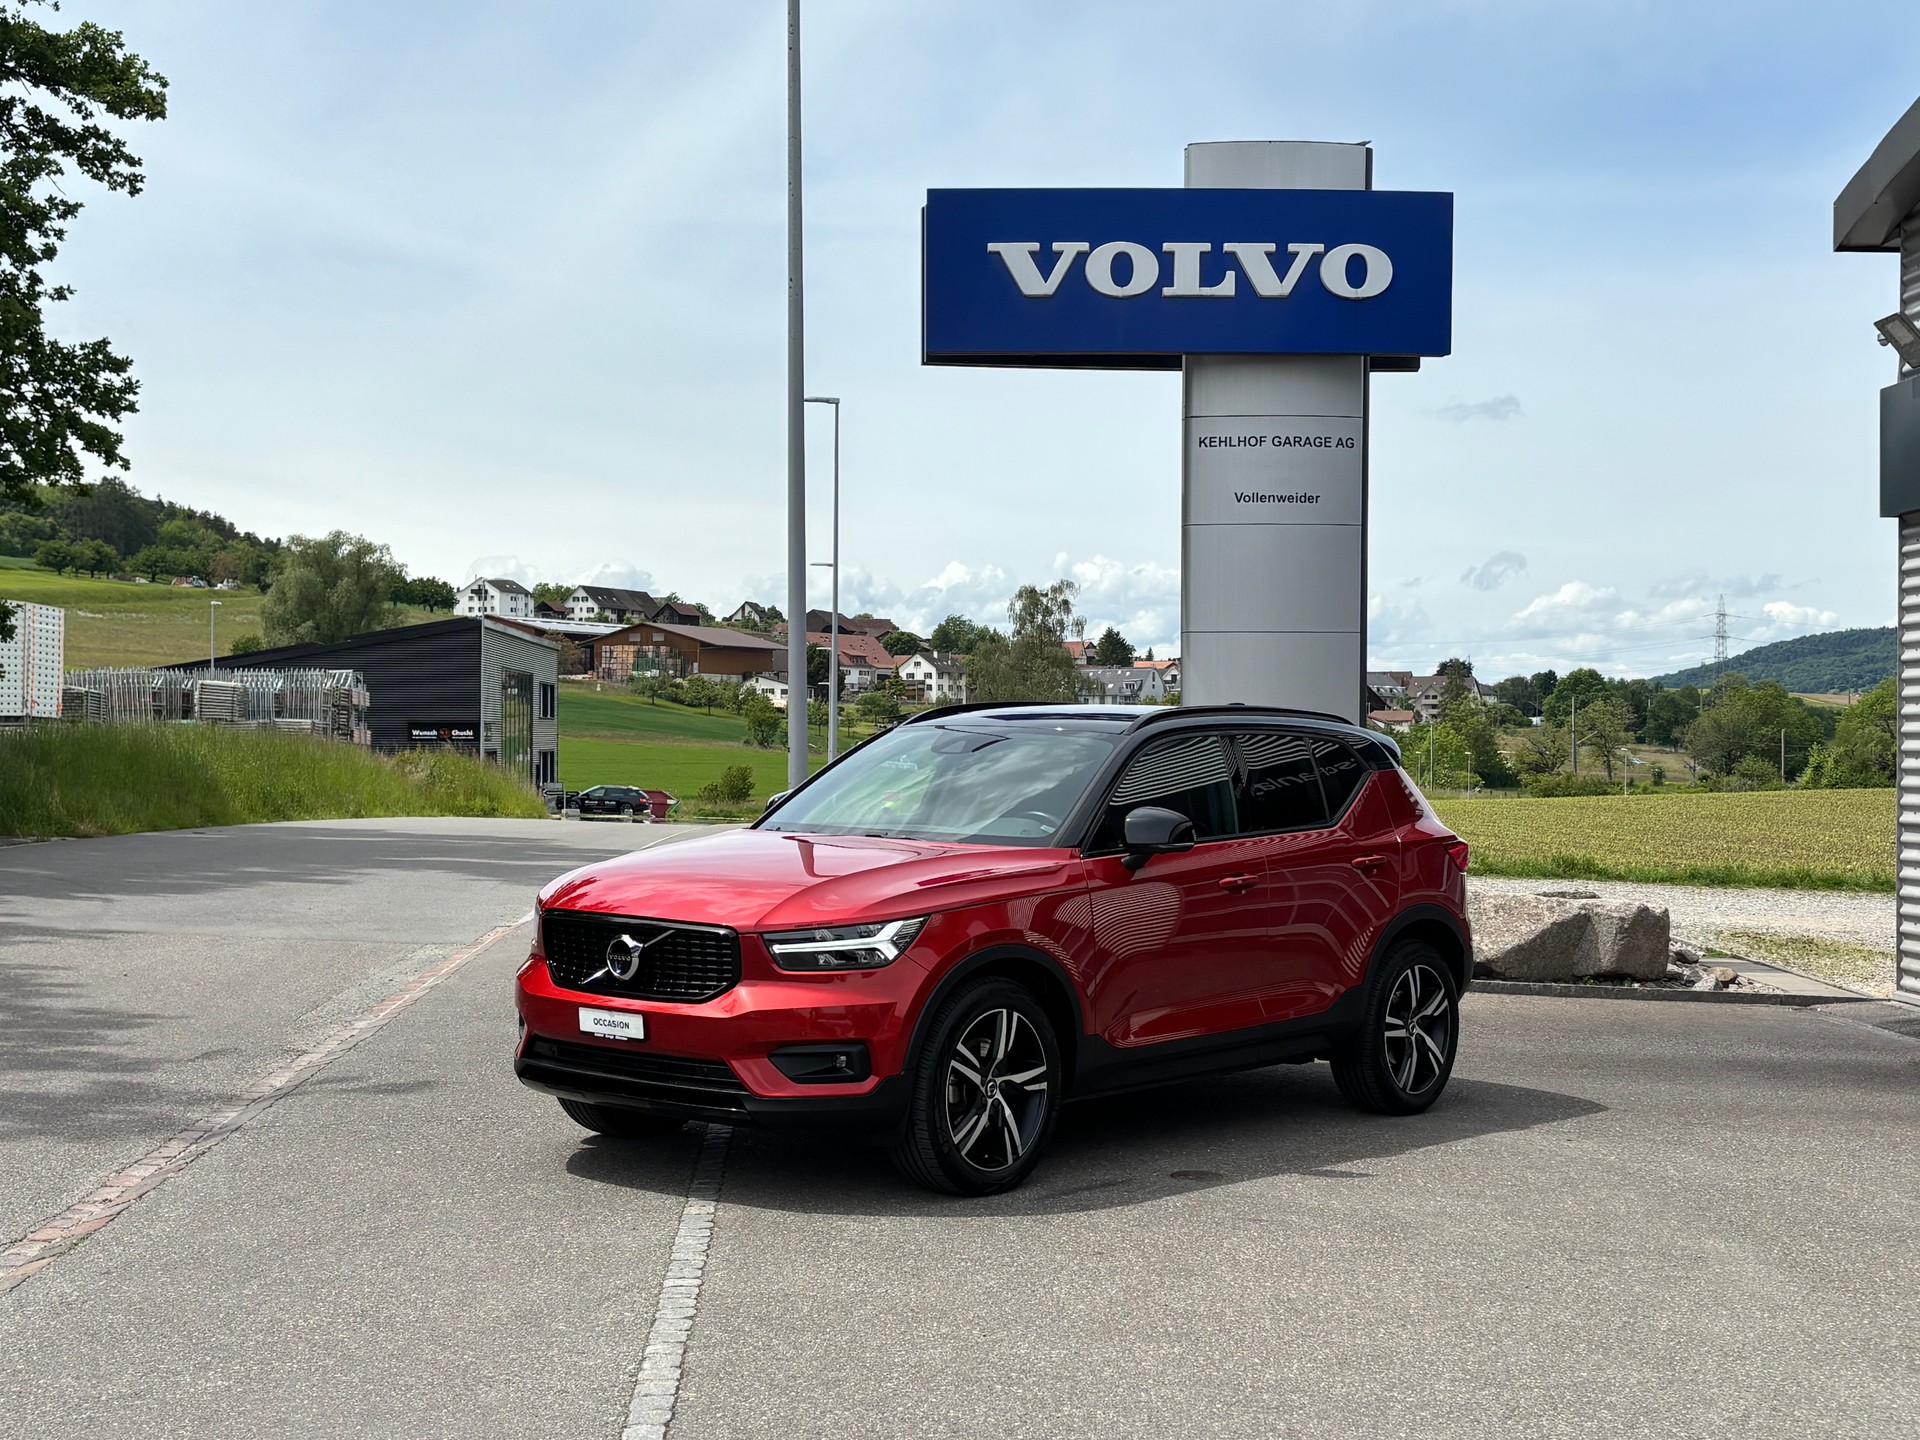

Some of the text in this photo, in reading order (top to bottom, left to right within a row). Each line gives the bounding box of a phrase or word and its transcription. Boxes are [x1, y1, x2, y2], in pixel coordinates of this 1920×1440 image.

[987, 241, 1394, 299] VOLVO
[1198, 436, 1355, 449] KEHLHOF GARAGE AG
[1234, 492, 1320, 504] Vollenweider
[609, 954, 631, 962] VOLVO
[593, 1017, 630, 1030] OCCASION
